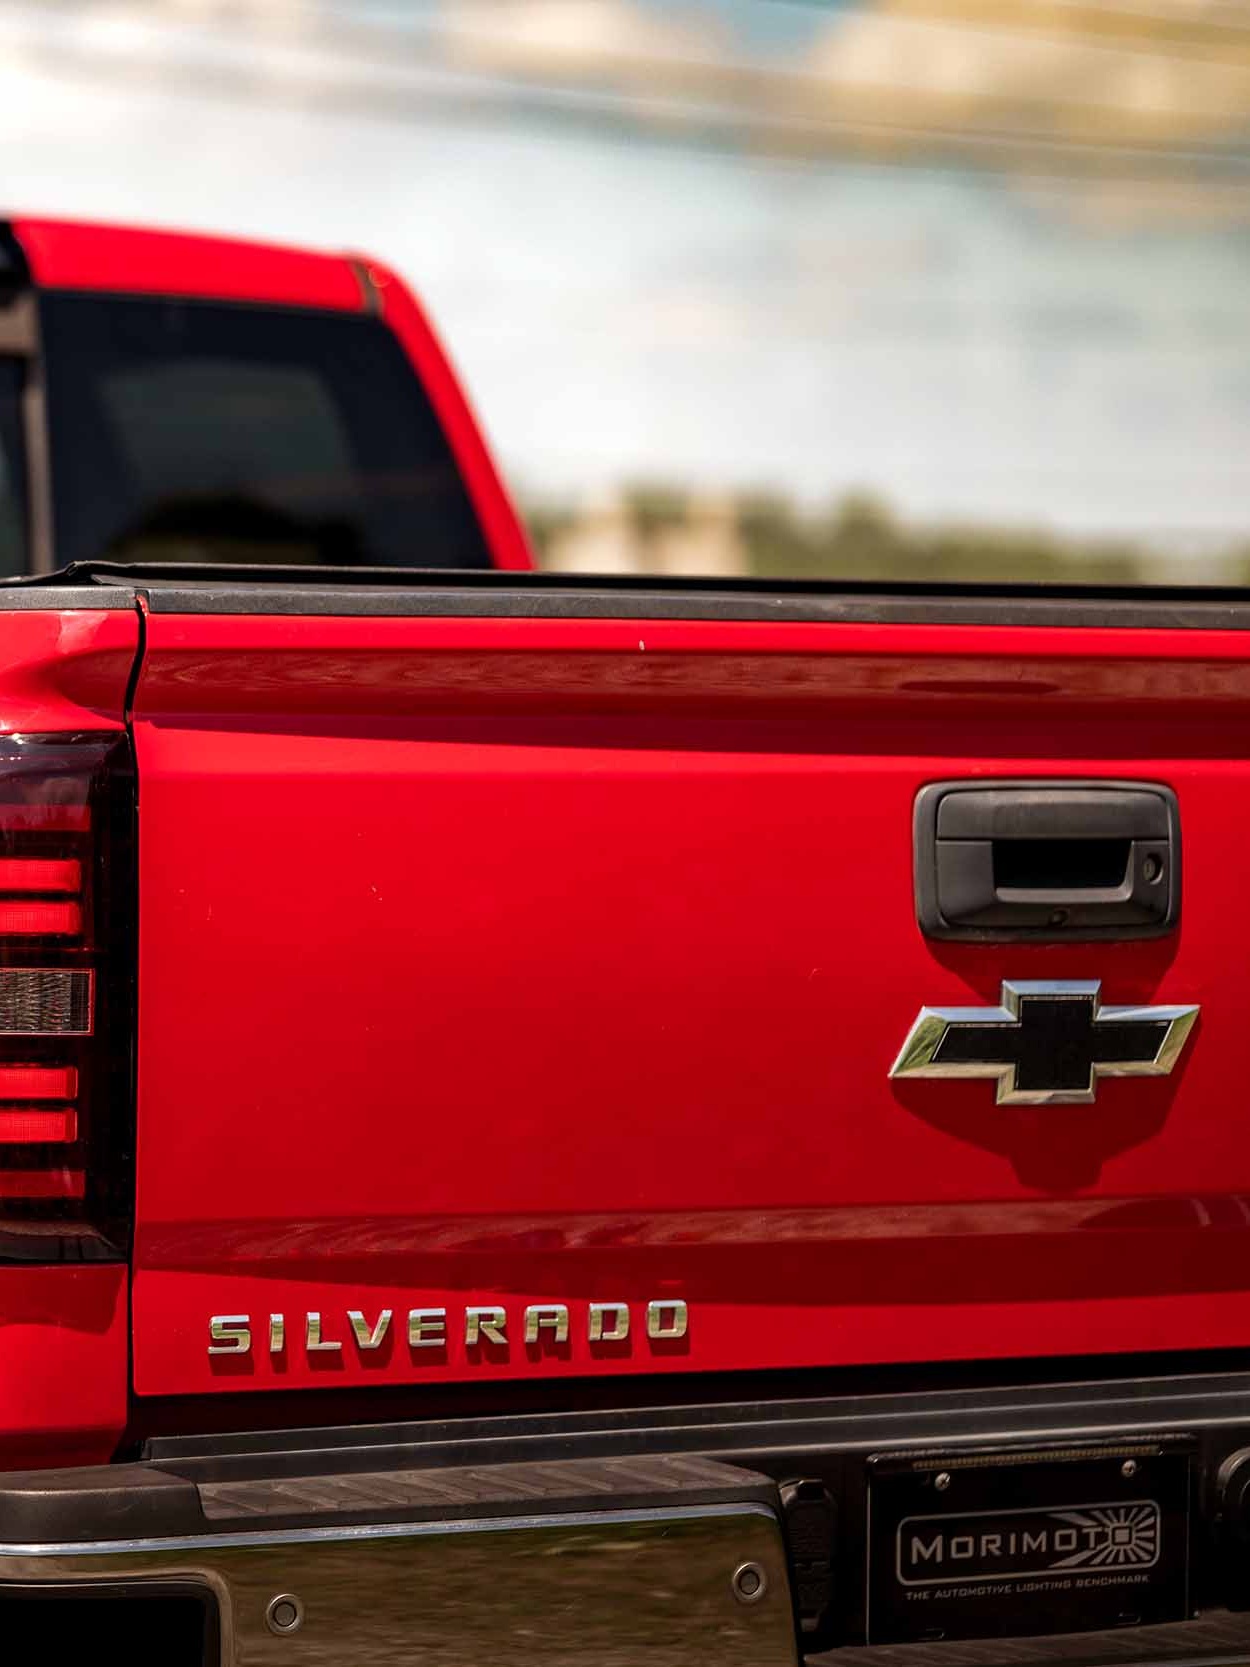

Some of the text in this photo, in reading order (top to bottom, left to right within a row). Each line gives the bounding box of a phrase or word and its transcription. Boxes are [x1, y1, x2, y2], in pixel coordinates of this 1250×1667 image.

[208, 1300, 688, 1354] SILVERADO
[906, 1574, 1150, 1601] THE AUTOMOTIVE LIGHTING BENCHMARK
